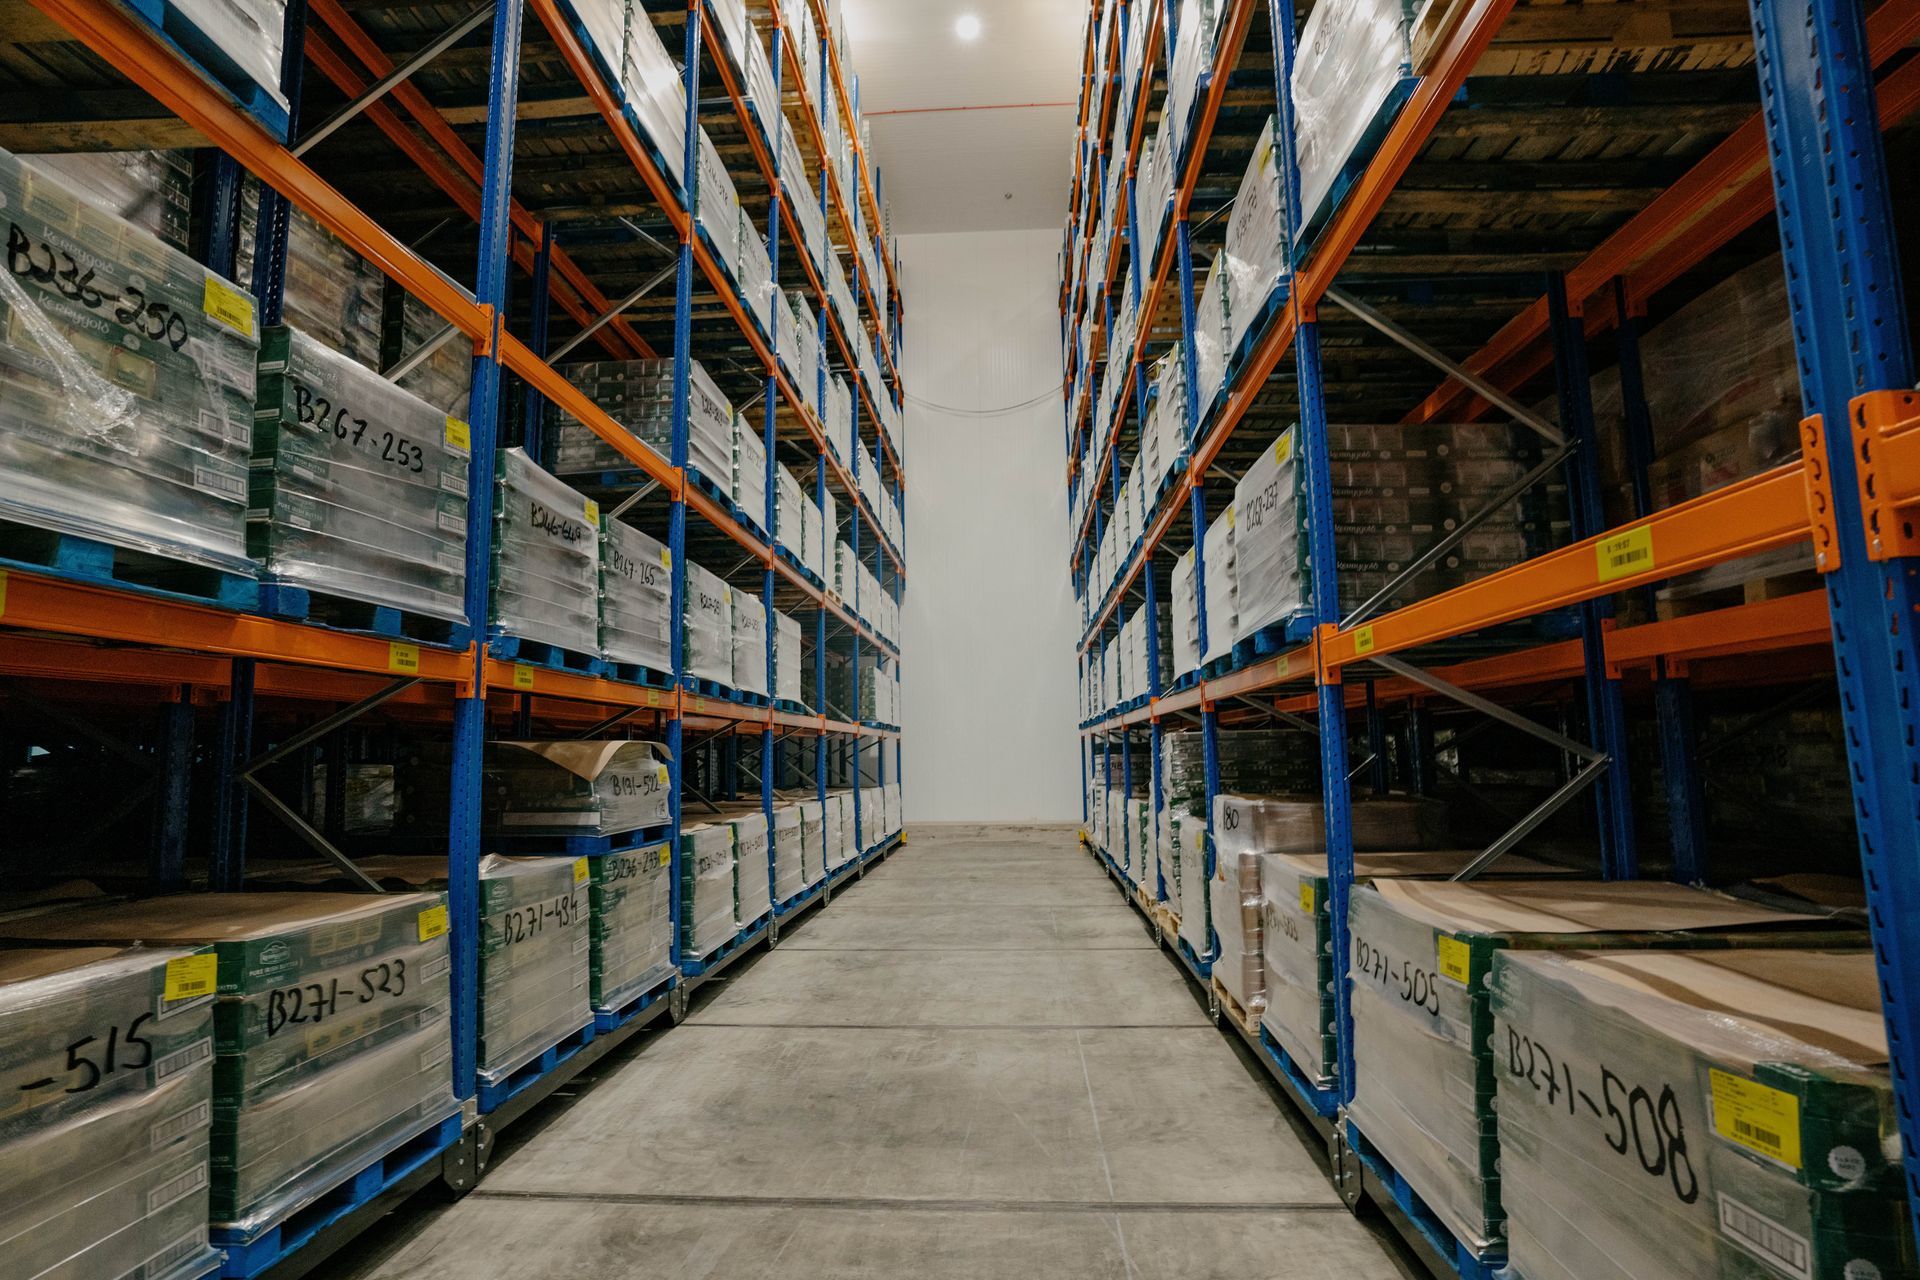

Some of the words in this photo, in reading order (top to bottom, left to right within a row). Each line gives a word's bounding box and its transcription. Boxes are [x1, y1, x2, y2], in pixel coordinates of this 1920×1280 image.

[7, 222, 188, 353] B236-250
[293, 384, 424, 473] B267-253
[267, 958, 406, 1038] B271-523
[1356, 936, 1440, 1017] B271-505
[1507, 1023, 1700, 1205] B271-508
